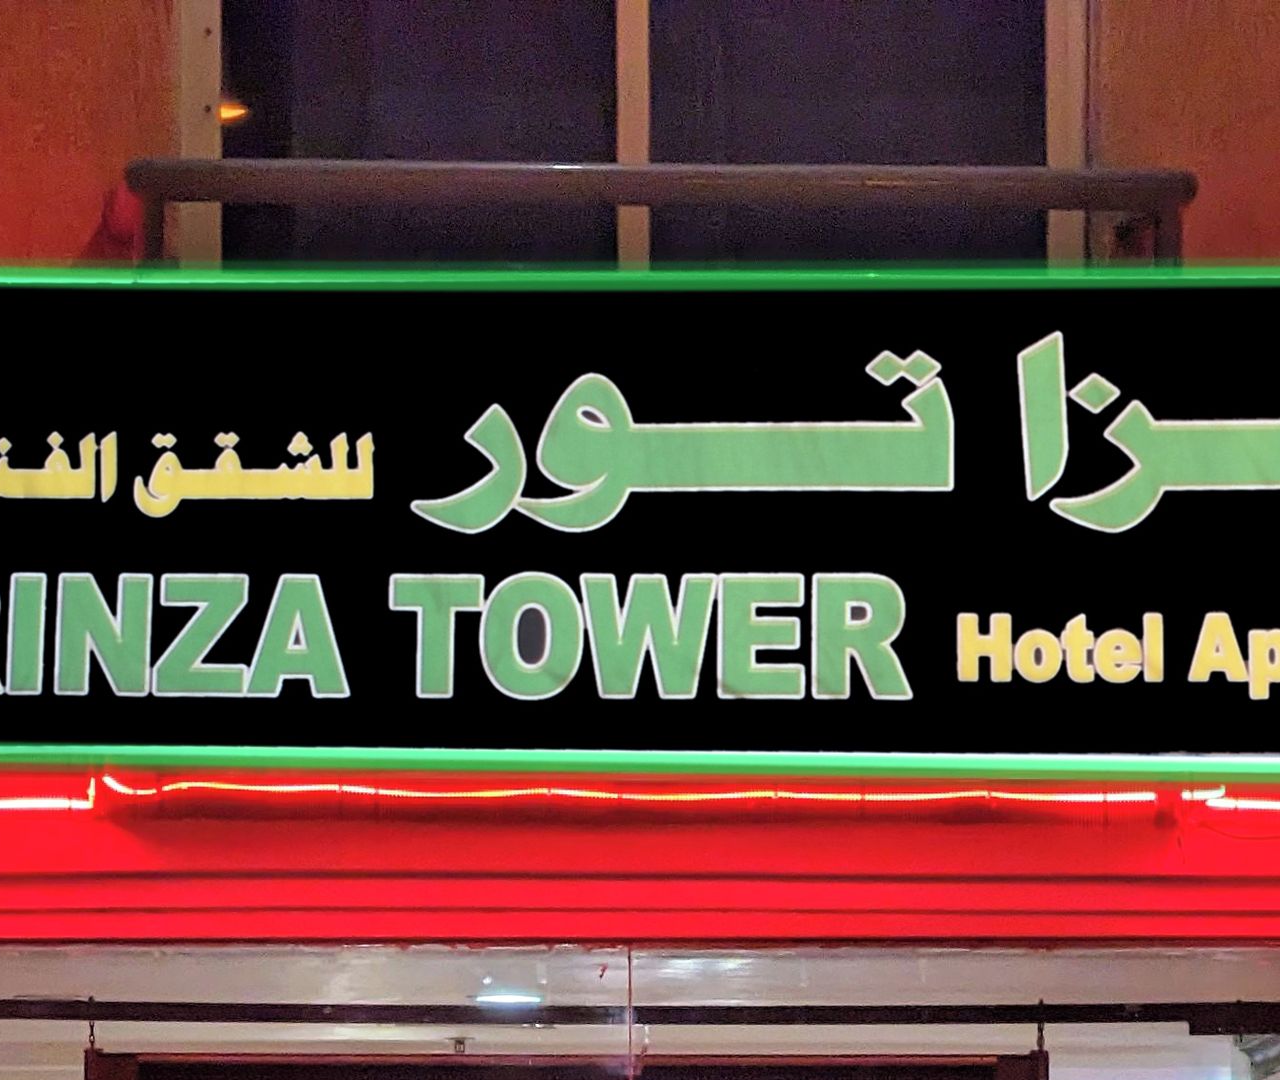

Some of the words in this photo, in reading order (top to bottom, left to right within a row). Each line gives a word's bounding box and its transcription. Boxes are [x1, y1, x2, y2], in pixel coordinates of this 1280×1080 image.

[134, 432, 376, 518] للشقق
[410, 350, 954, 534] تور
[388, 571, 913, 701] TOWER
[957, 612, 1164, 683] Hotel
